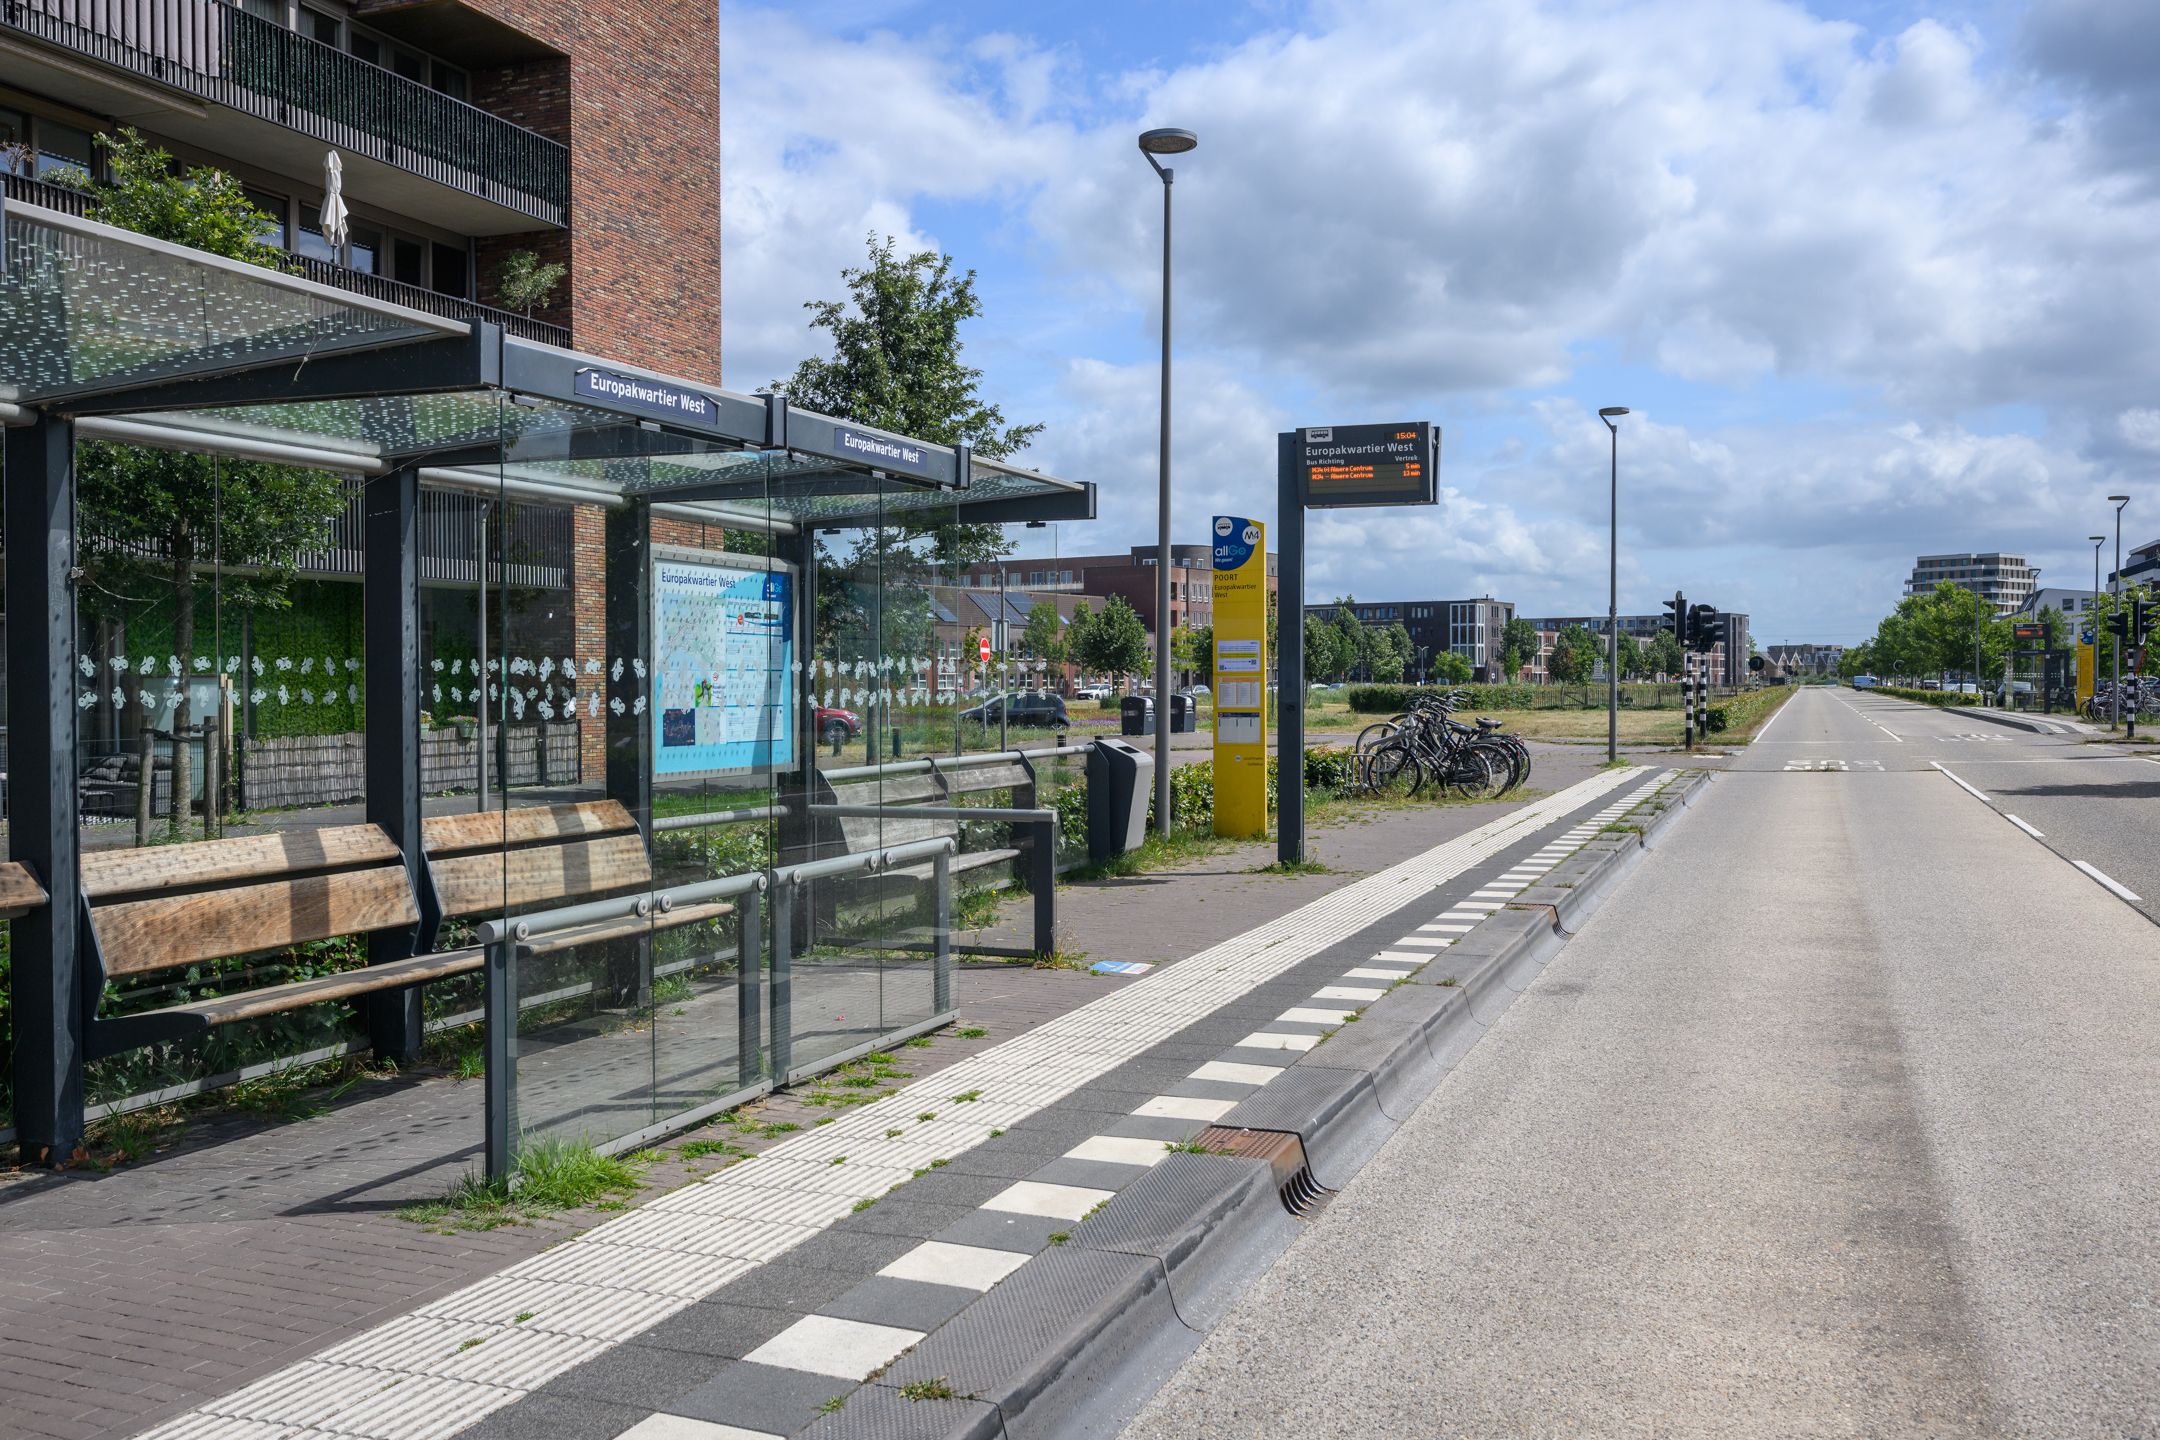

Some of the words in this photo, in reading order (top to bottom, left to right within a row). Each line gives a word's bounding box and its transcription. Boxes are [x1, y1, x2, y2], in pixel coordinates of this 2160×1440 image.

[590, 372, 678, 409] Europakwartier
[680, 393, 705, 415] West
[1396, 431, 1417, 440] 15:04
[843, 432, 900, 458] Europakwartier
[902, 447, 919, 464] West
[1306, 443, 1385, 457] Europakwartier
[1387, 442, 1414, 452] West
[1318, 458, 1345, 466] Richting
[1395, 454, 1418, 462] Vertrek
[1244, 530, 1260, 540] M4
[1214, 545, 1247, 557] allGo
[661, 571, 717, 586] Europakwartier
[718, 577, 736, 589] West
[1214, 573, 1238, 582] POORT
